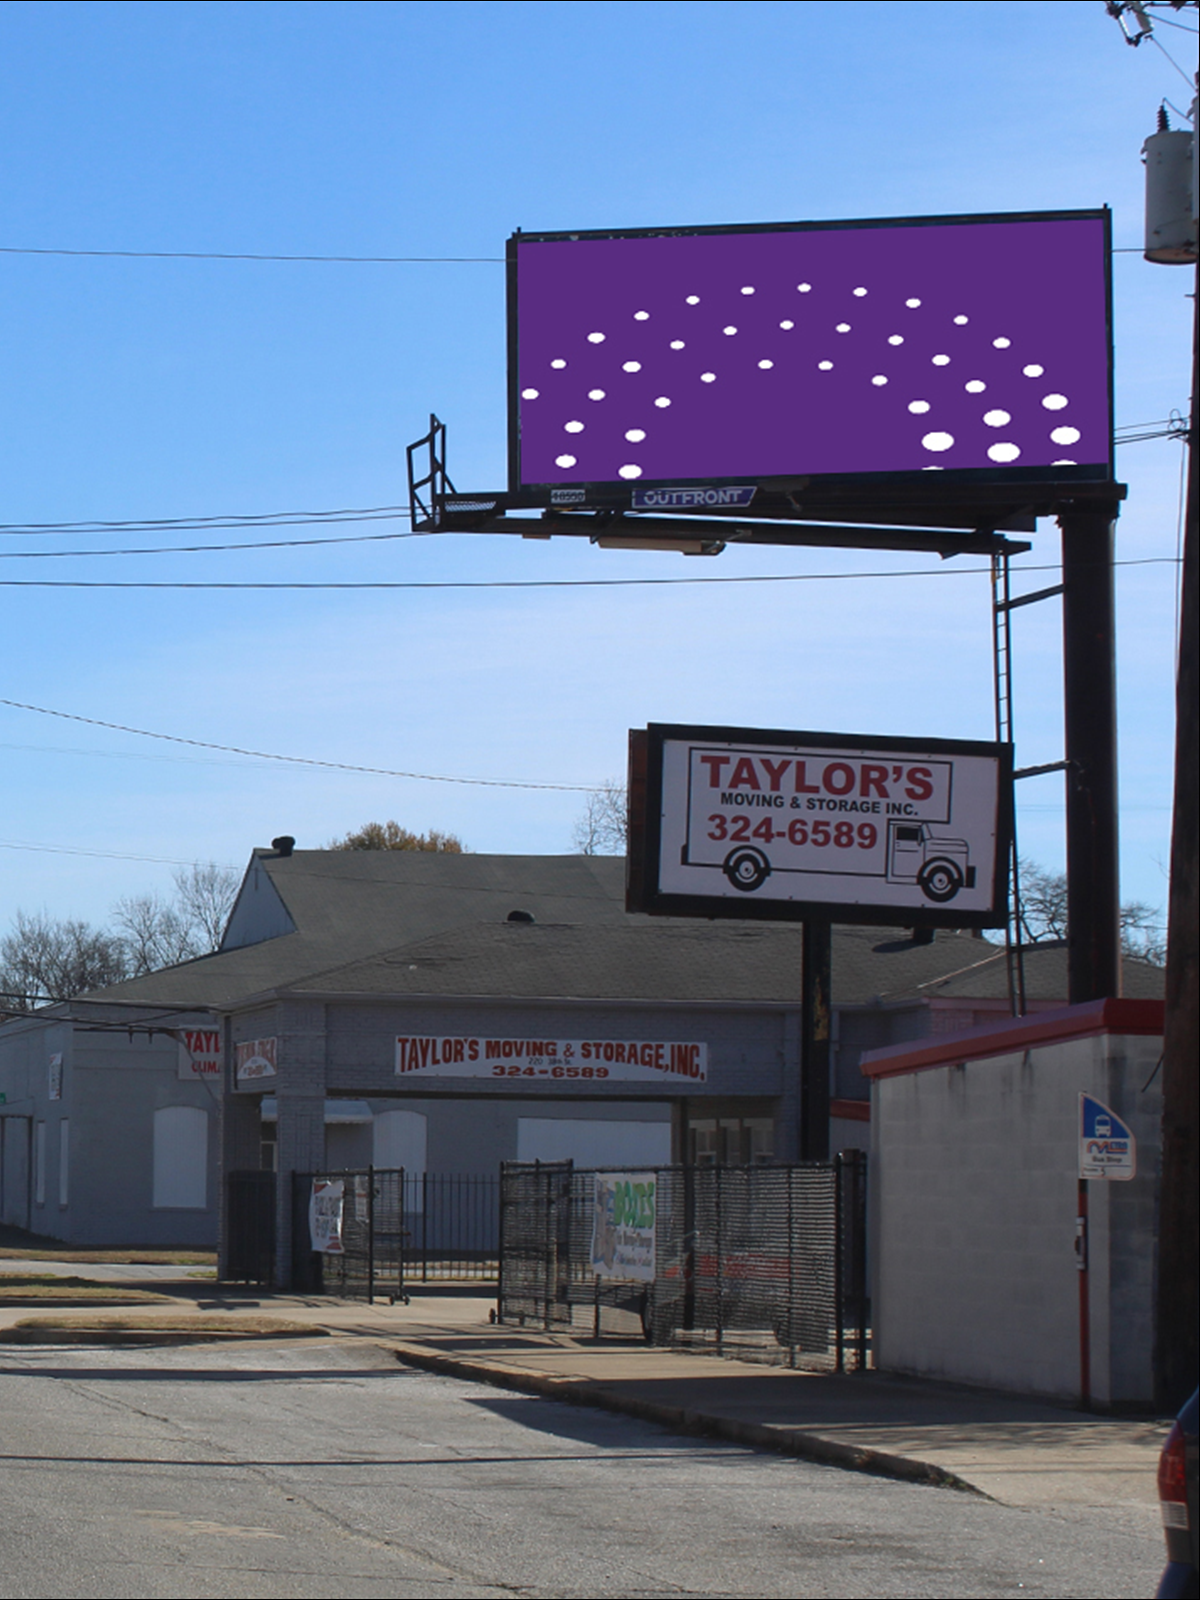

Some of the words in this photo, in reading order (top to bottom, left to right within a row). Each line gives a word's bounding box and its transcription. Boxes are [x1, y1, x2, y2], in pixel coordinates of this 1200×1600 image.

[643, 489, 742, 505] OUTFRONT
[700, 755, 934, 801] TAYLOR'S
[720, 792, 784, 809] MOVING
[789, 797, 800, 809] &
[806, 798, 881, 815] STORAGE
[885, 803, 919, 816] INC.
[706, 814, 878, 849] 324-6589
[398, 1038, 480, 1073] TAYLOR'S
[485, 1040, 557, 1060] MOVING
[563, 1044, 575, 1059] &
[492, 1066, 609, 1078] 324-6589
